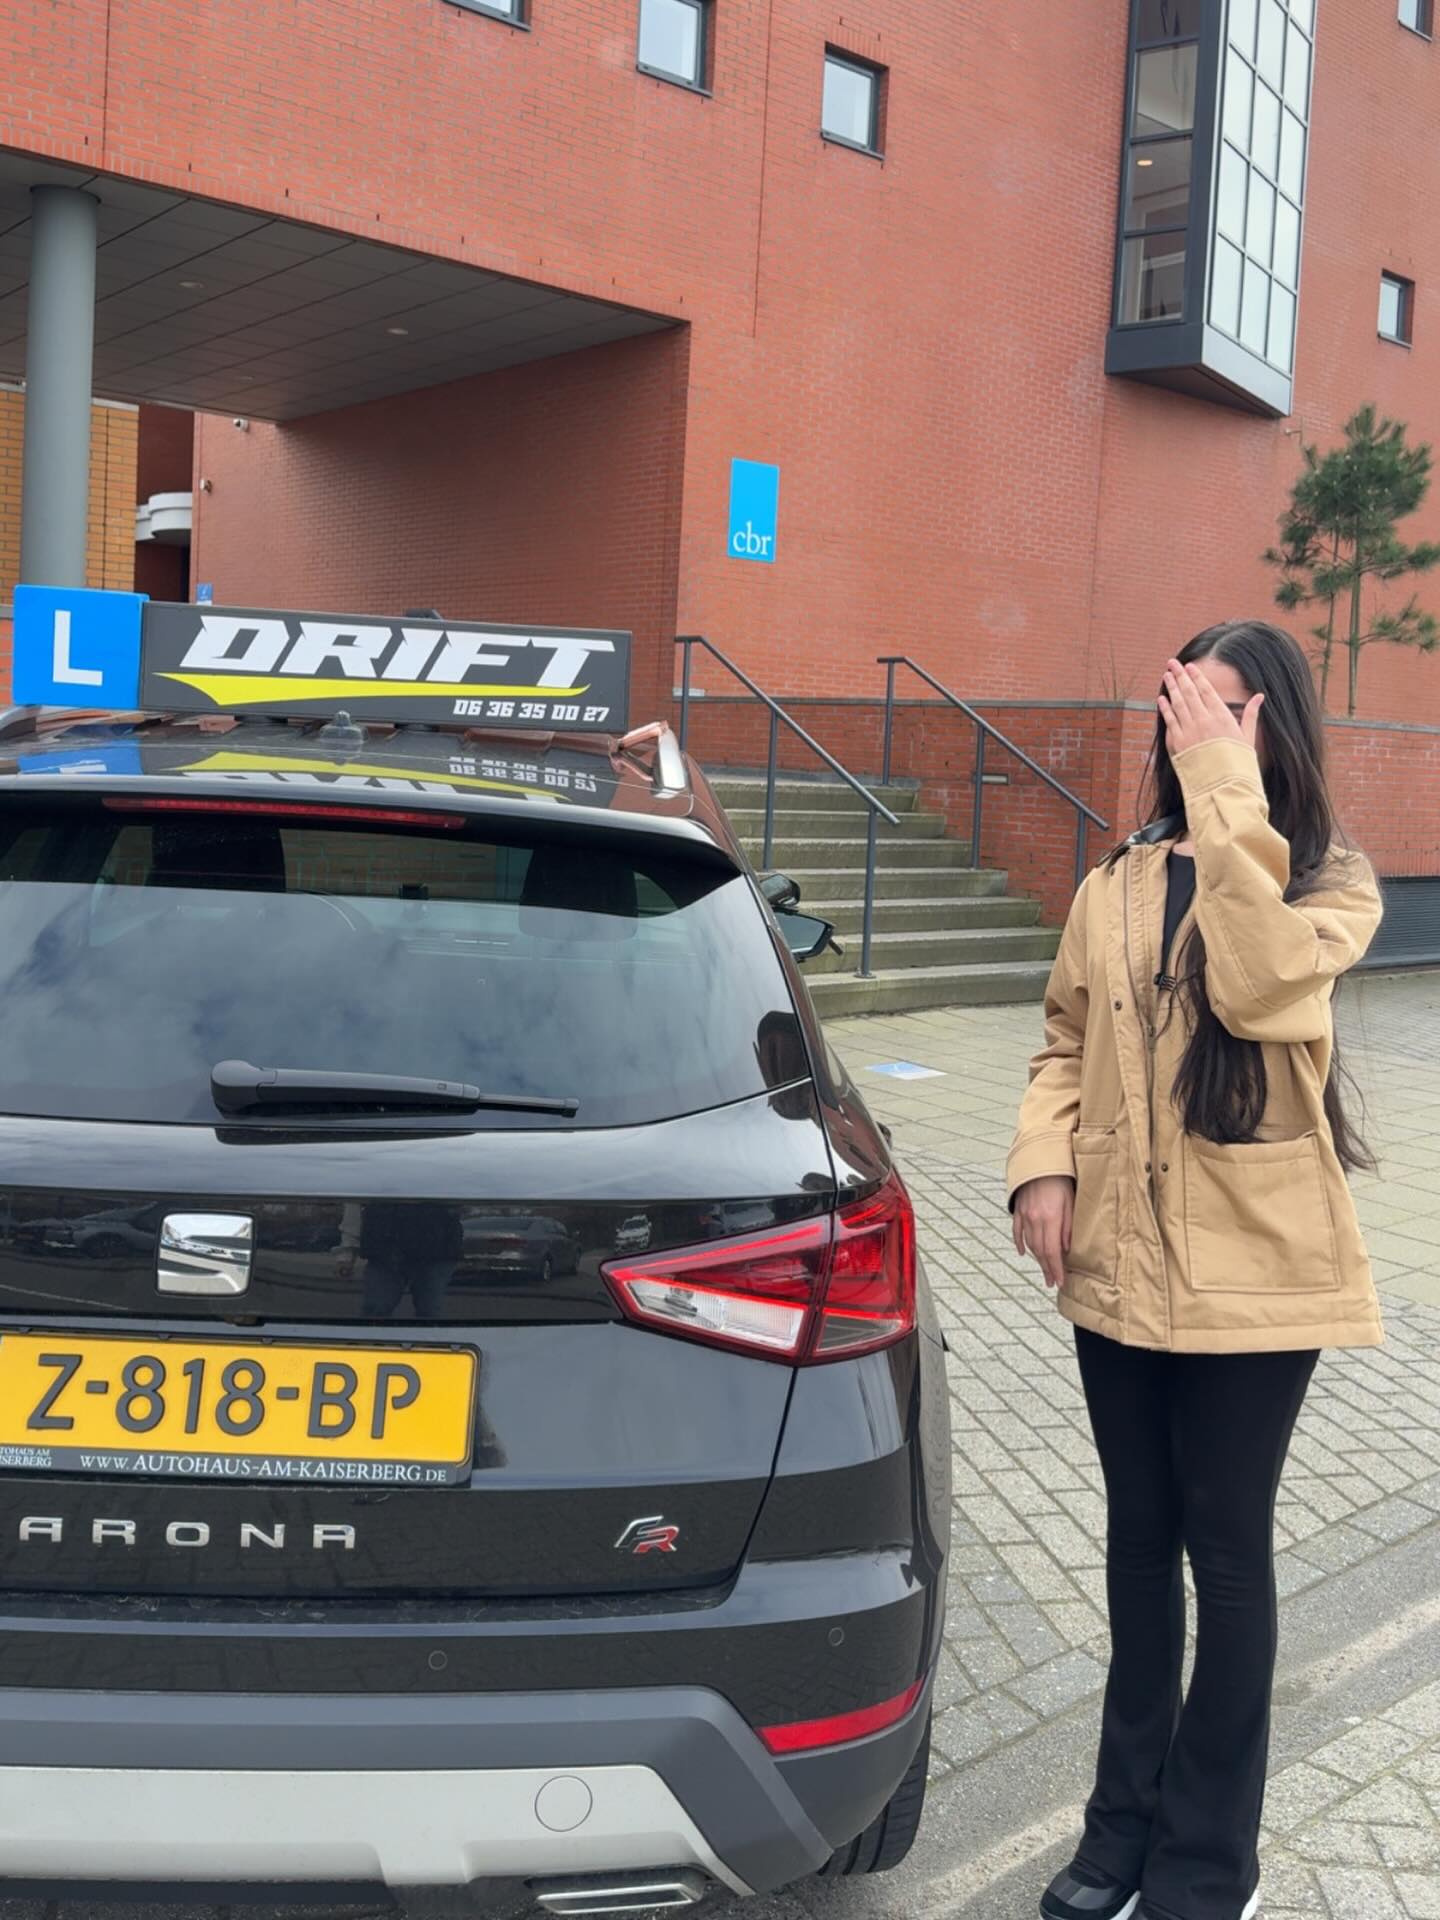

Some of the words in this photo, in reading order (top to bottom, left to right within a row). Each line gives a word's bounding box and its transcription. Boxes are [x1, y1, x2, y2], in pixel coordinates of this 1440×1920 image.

[733, 520, 772, 556] cbr
[53, 610, 103, 686] L
[180, 615, 615, 689] DRIFT
[453, 699, 483, 716] 06
[486, 701, 515, 718] 36
[518, 703, 547, 719] 35
[551, 704, 580, 721] 00
[583, 706, 610, 722] 27
[27, 1353, 421, 1440] Z-818-BP
[19, 1516, 356, 1549] ARONA
